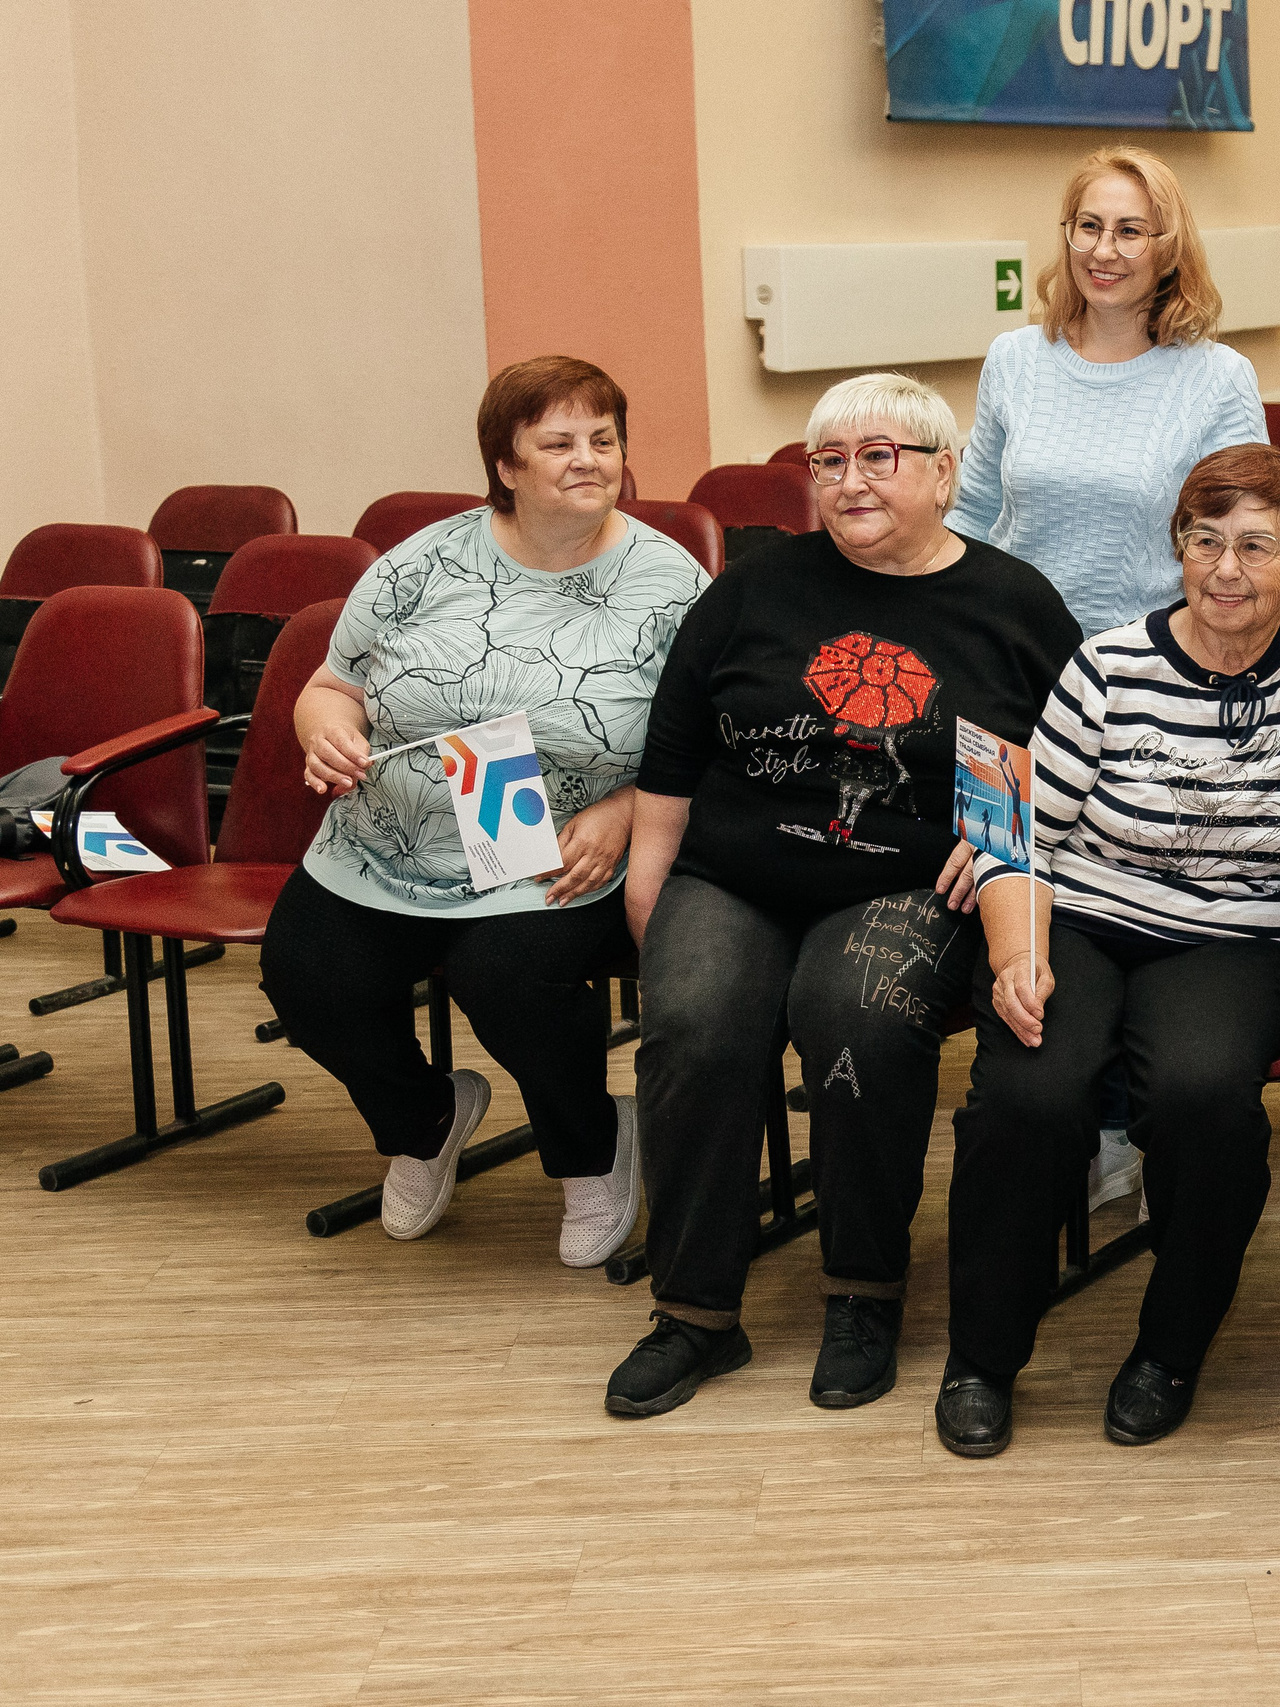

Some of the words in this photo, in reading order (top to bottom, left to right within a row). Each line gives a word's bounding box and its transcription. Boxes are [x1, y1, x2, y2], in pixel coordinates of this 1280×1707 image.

[1059, 0, 1232, 71] СПОРТ
[746, 744, 821, 784] Style
[823, 1047, 861, 1099] A
